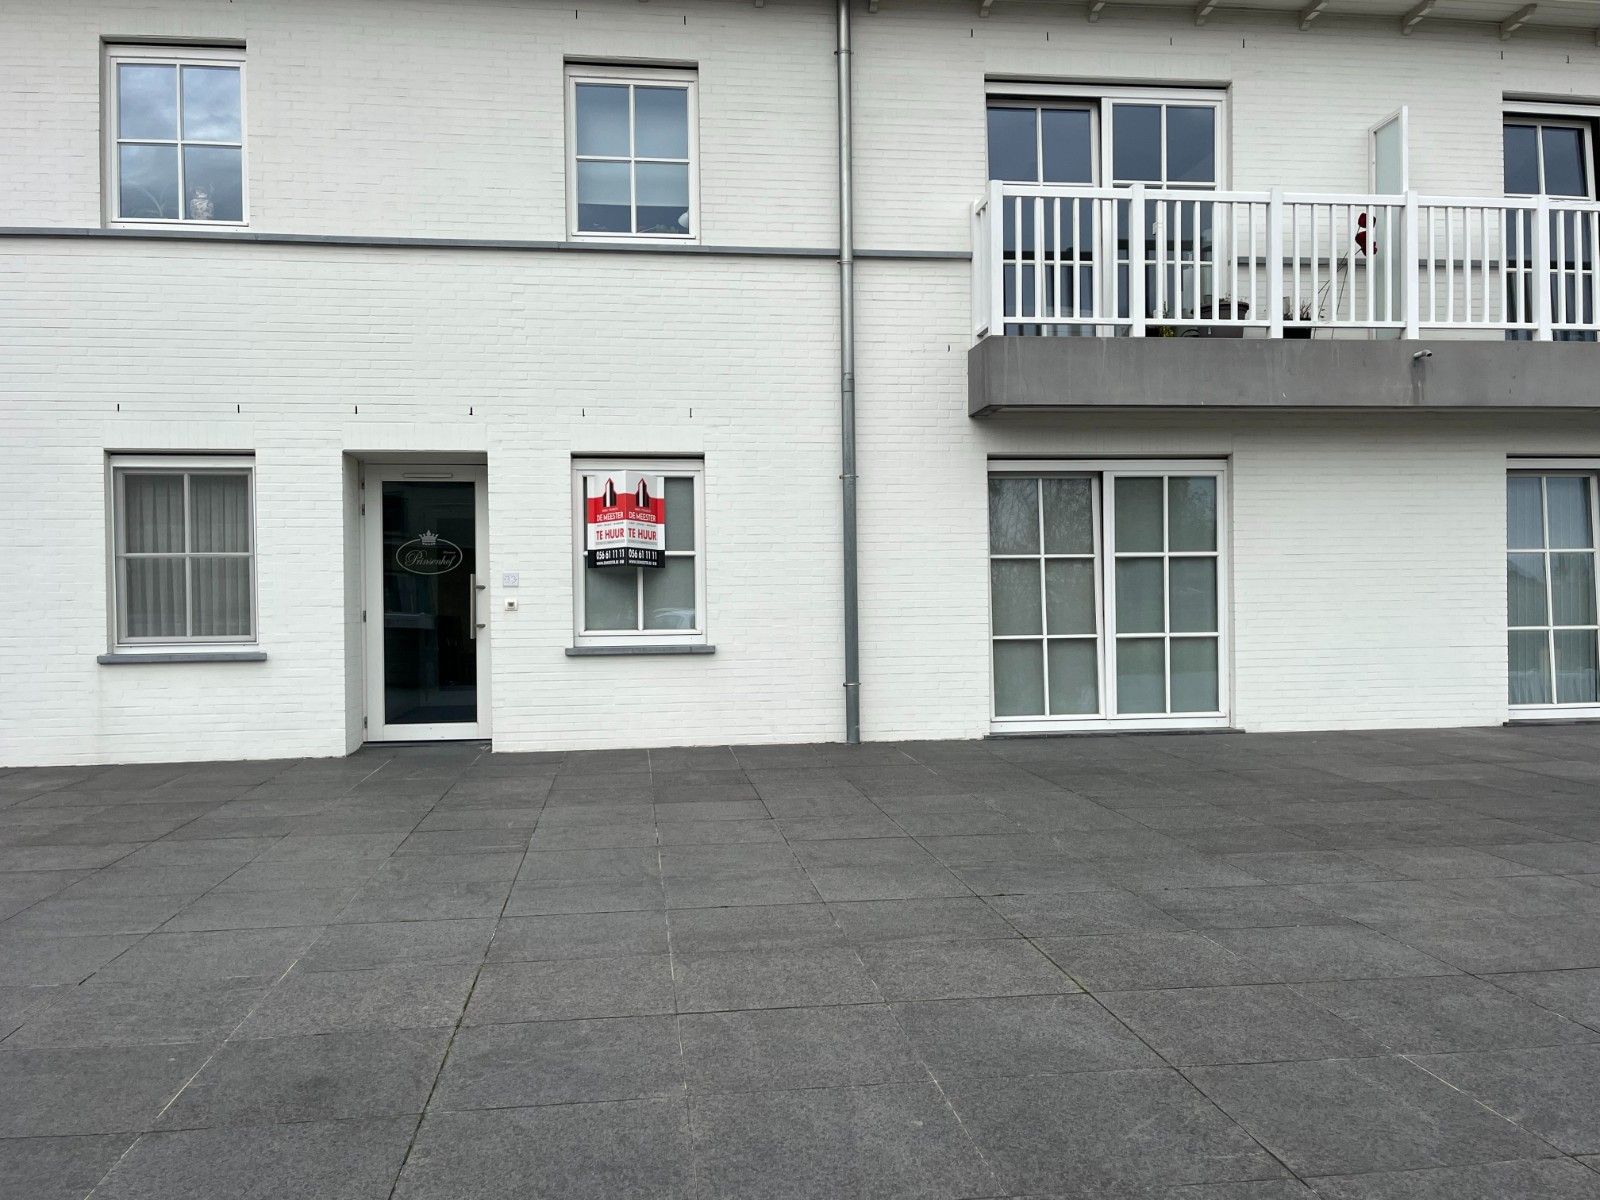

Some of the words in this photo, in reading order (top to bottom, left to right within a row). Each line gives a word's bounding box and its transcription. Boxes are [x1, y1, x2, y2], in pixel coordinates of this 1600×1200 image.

[603, 512, 624, 521] MEESTER
[636, 513, 656, 522] MEESTER
[596, 530, 603, 540] TE
[605, 528, 624, 539] HUUR
[628, 528, 635, 538] TE
[638, 529, 657, 540] HUUR
[596, 550, 604, 560] 056
[612, 549, 618, 558] 11
[619, 549, 624, 558] 11
[628, 549, 638, 558] 056
[639, 550, 644, 559] 61
[646, 550, 650, 559] 11
[652, 551, 657, 560] 11
